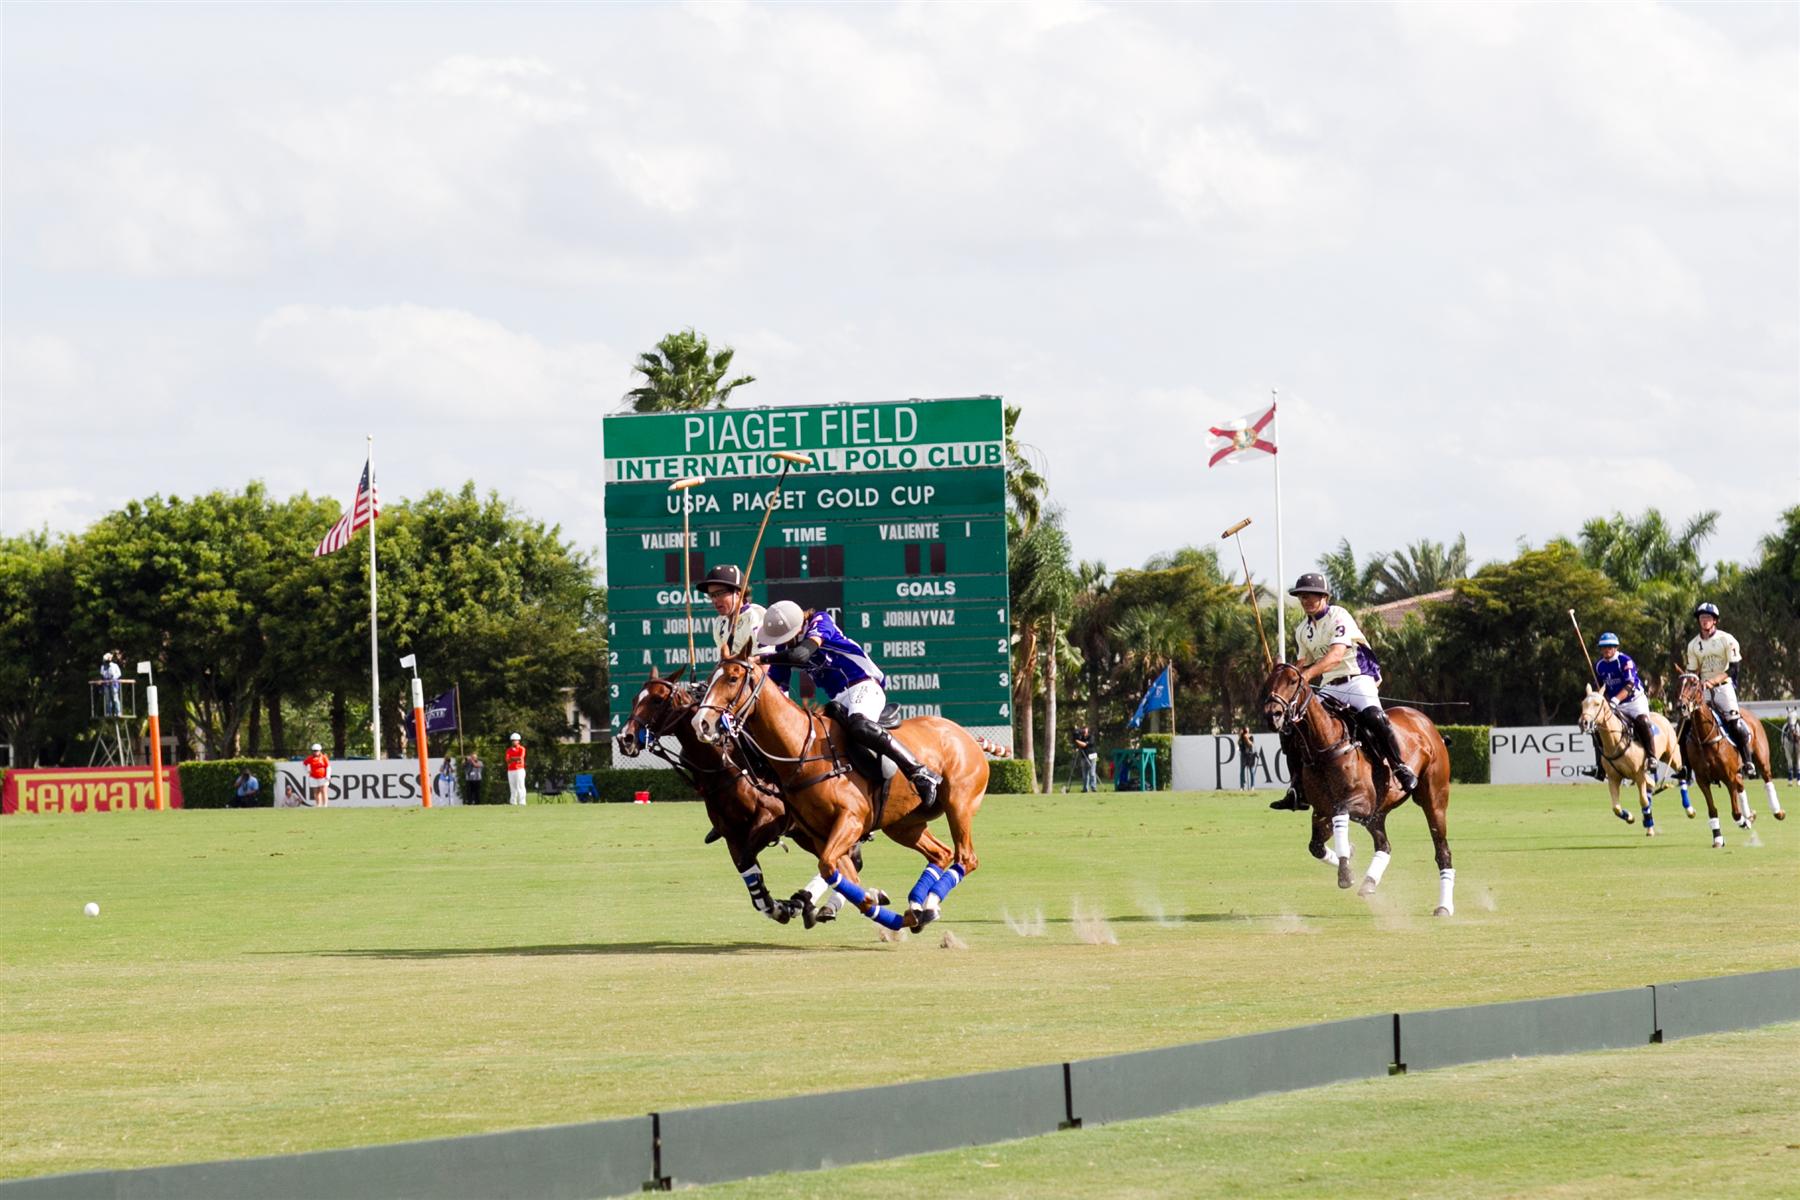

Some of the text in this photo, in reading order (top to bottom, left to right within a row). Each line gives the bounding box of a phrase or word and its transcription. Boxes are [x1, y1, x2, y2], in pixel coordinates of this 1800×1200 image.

[684, 407, 918, 452] PIAGET FIELD
[845, 448, 917, 470] POLO
[928, 444, 1002, 467] CLUB
[667, 486, 935, 514] USPA PIAGET GOLD CUP
[782, 526, 827, 542] TIME
[879, 522, 940, 541] VALIENTE
[896, 581, 956, 596] GOALS
[861, 609, 1005, 628] B JORNAYVAZ 1
[608, 622, 616, 635] 1
[642, 619, 651, 635] R
[1306, 625, 1314, 639] 3
[1335, 625, 1345, 638] 3
[883, 641, 926, 657] PIERES
[998, 639, 1008, 653] 2
[609, 652, 618, 665] 2
[643, 650, 652, 665] A
[884, 673, 1009, 690] ASTRADA 3
[610, 684, 620, 698] 3
[898, 703, 1009, 719] TRADA 4
[611, 714, 621, 727] 4
[14, 770, 170, 813] Ferrari
